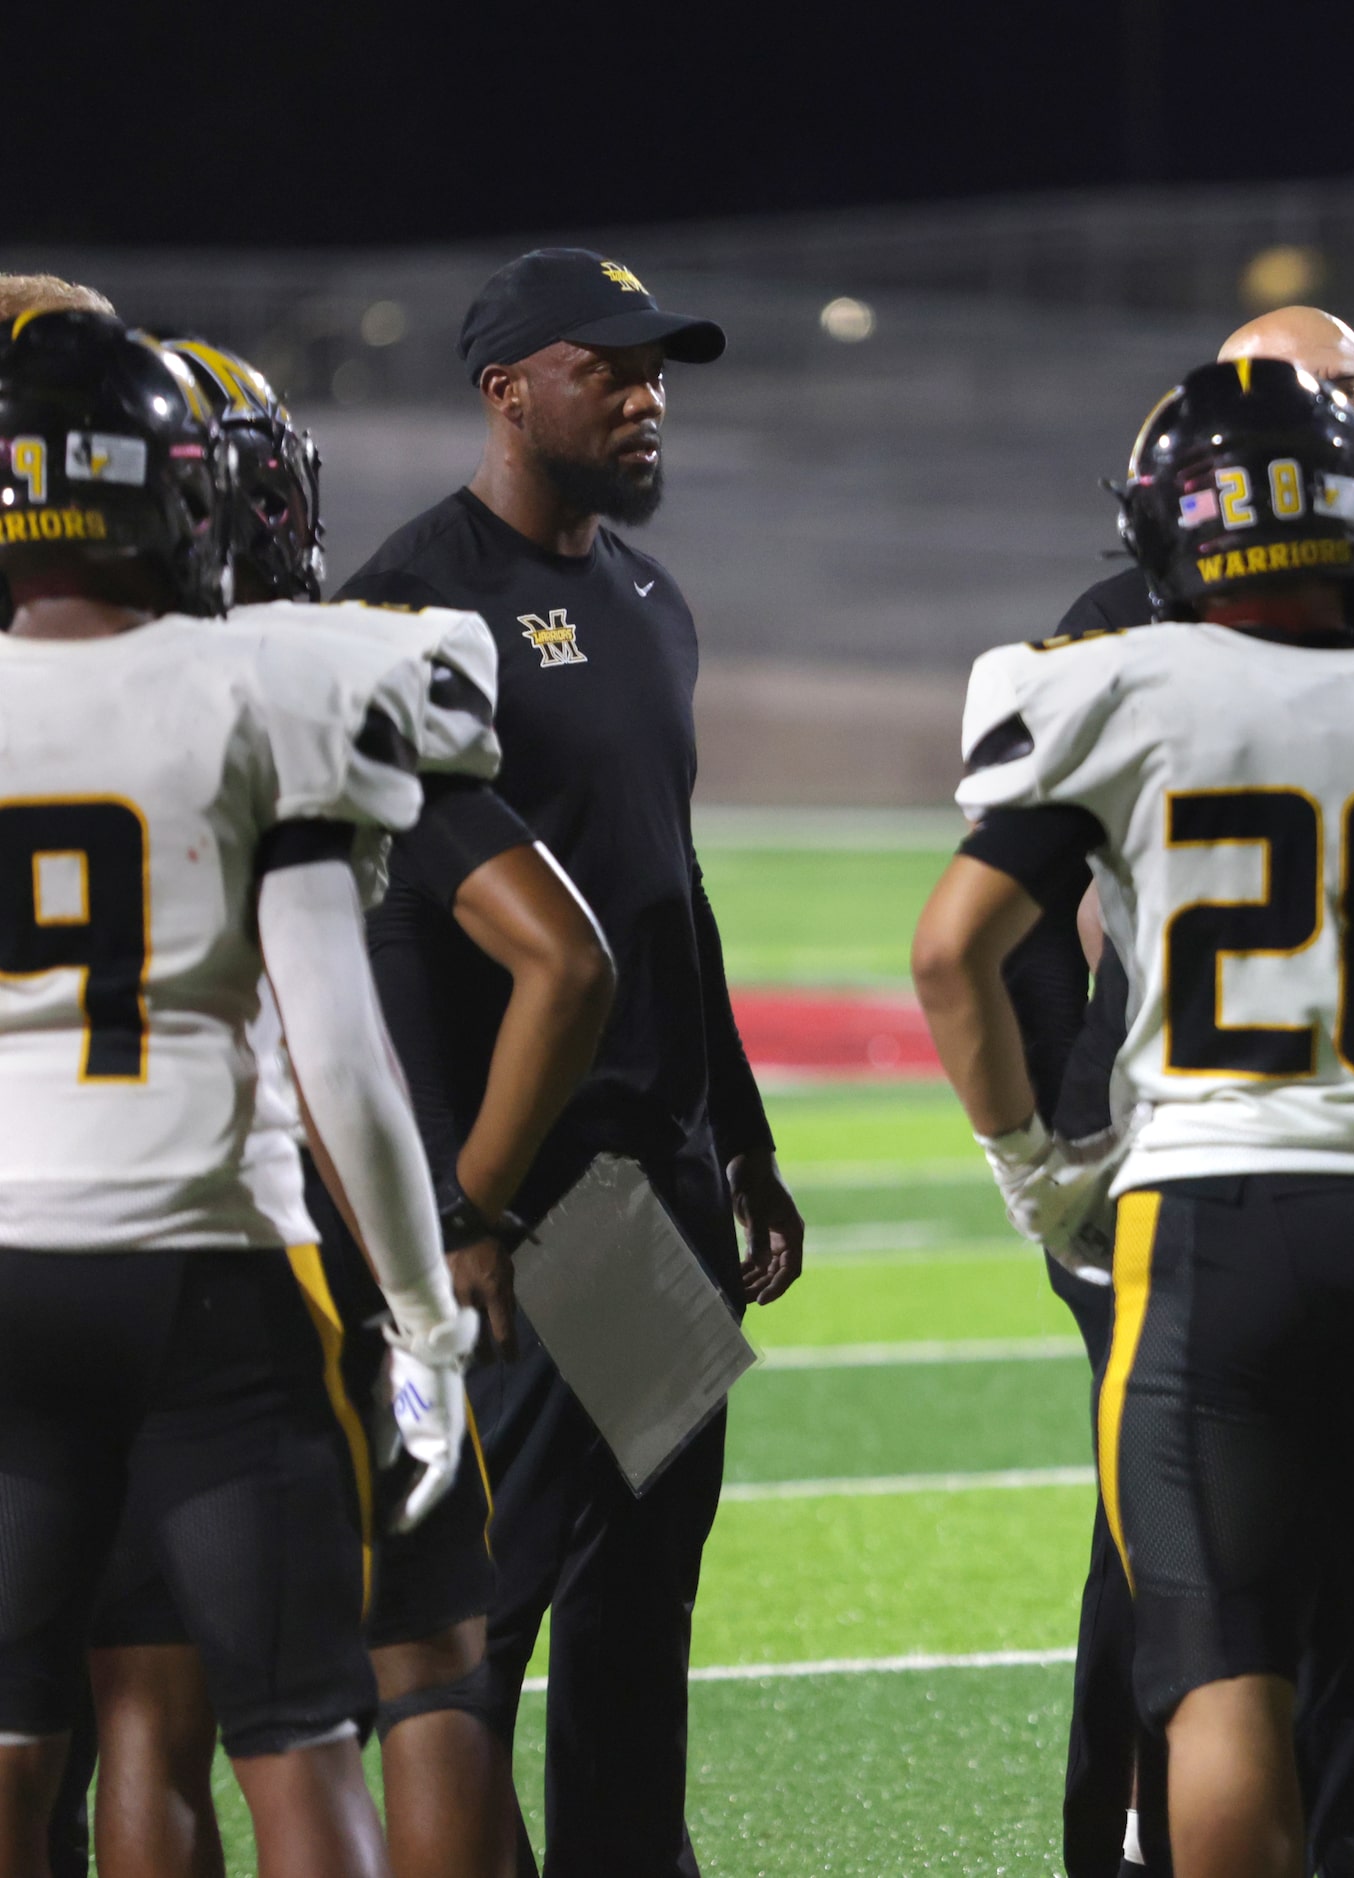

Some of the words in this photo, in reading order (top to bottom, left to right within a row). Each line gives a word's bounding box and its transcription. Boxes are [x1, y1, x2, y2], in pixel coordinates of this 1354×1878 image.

[12, 433, 48, 504] 9
[1214, 457, 1306, 531] 28
[1197, 538, 1354, 584] WARRIORS
[517, 608, 588, 668] M
[532, 627, 575, 645] WARRIORS
[0, 793, 151, 1085] 9
